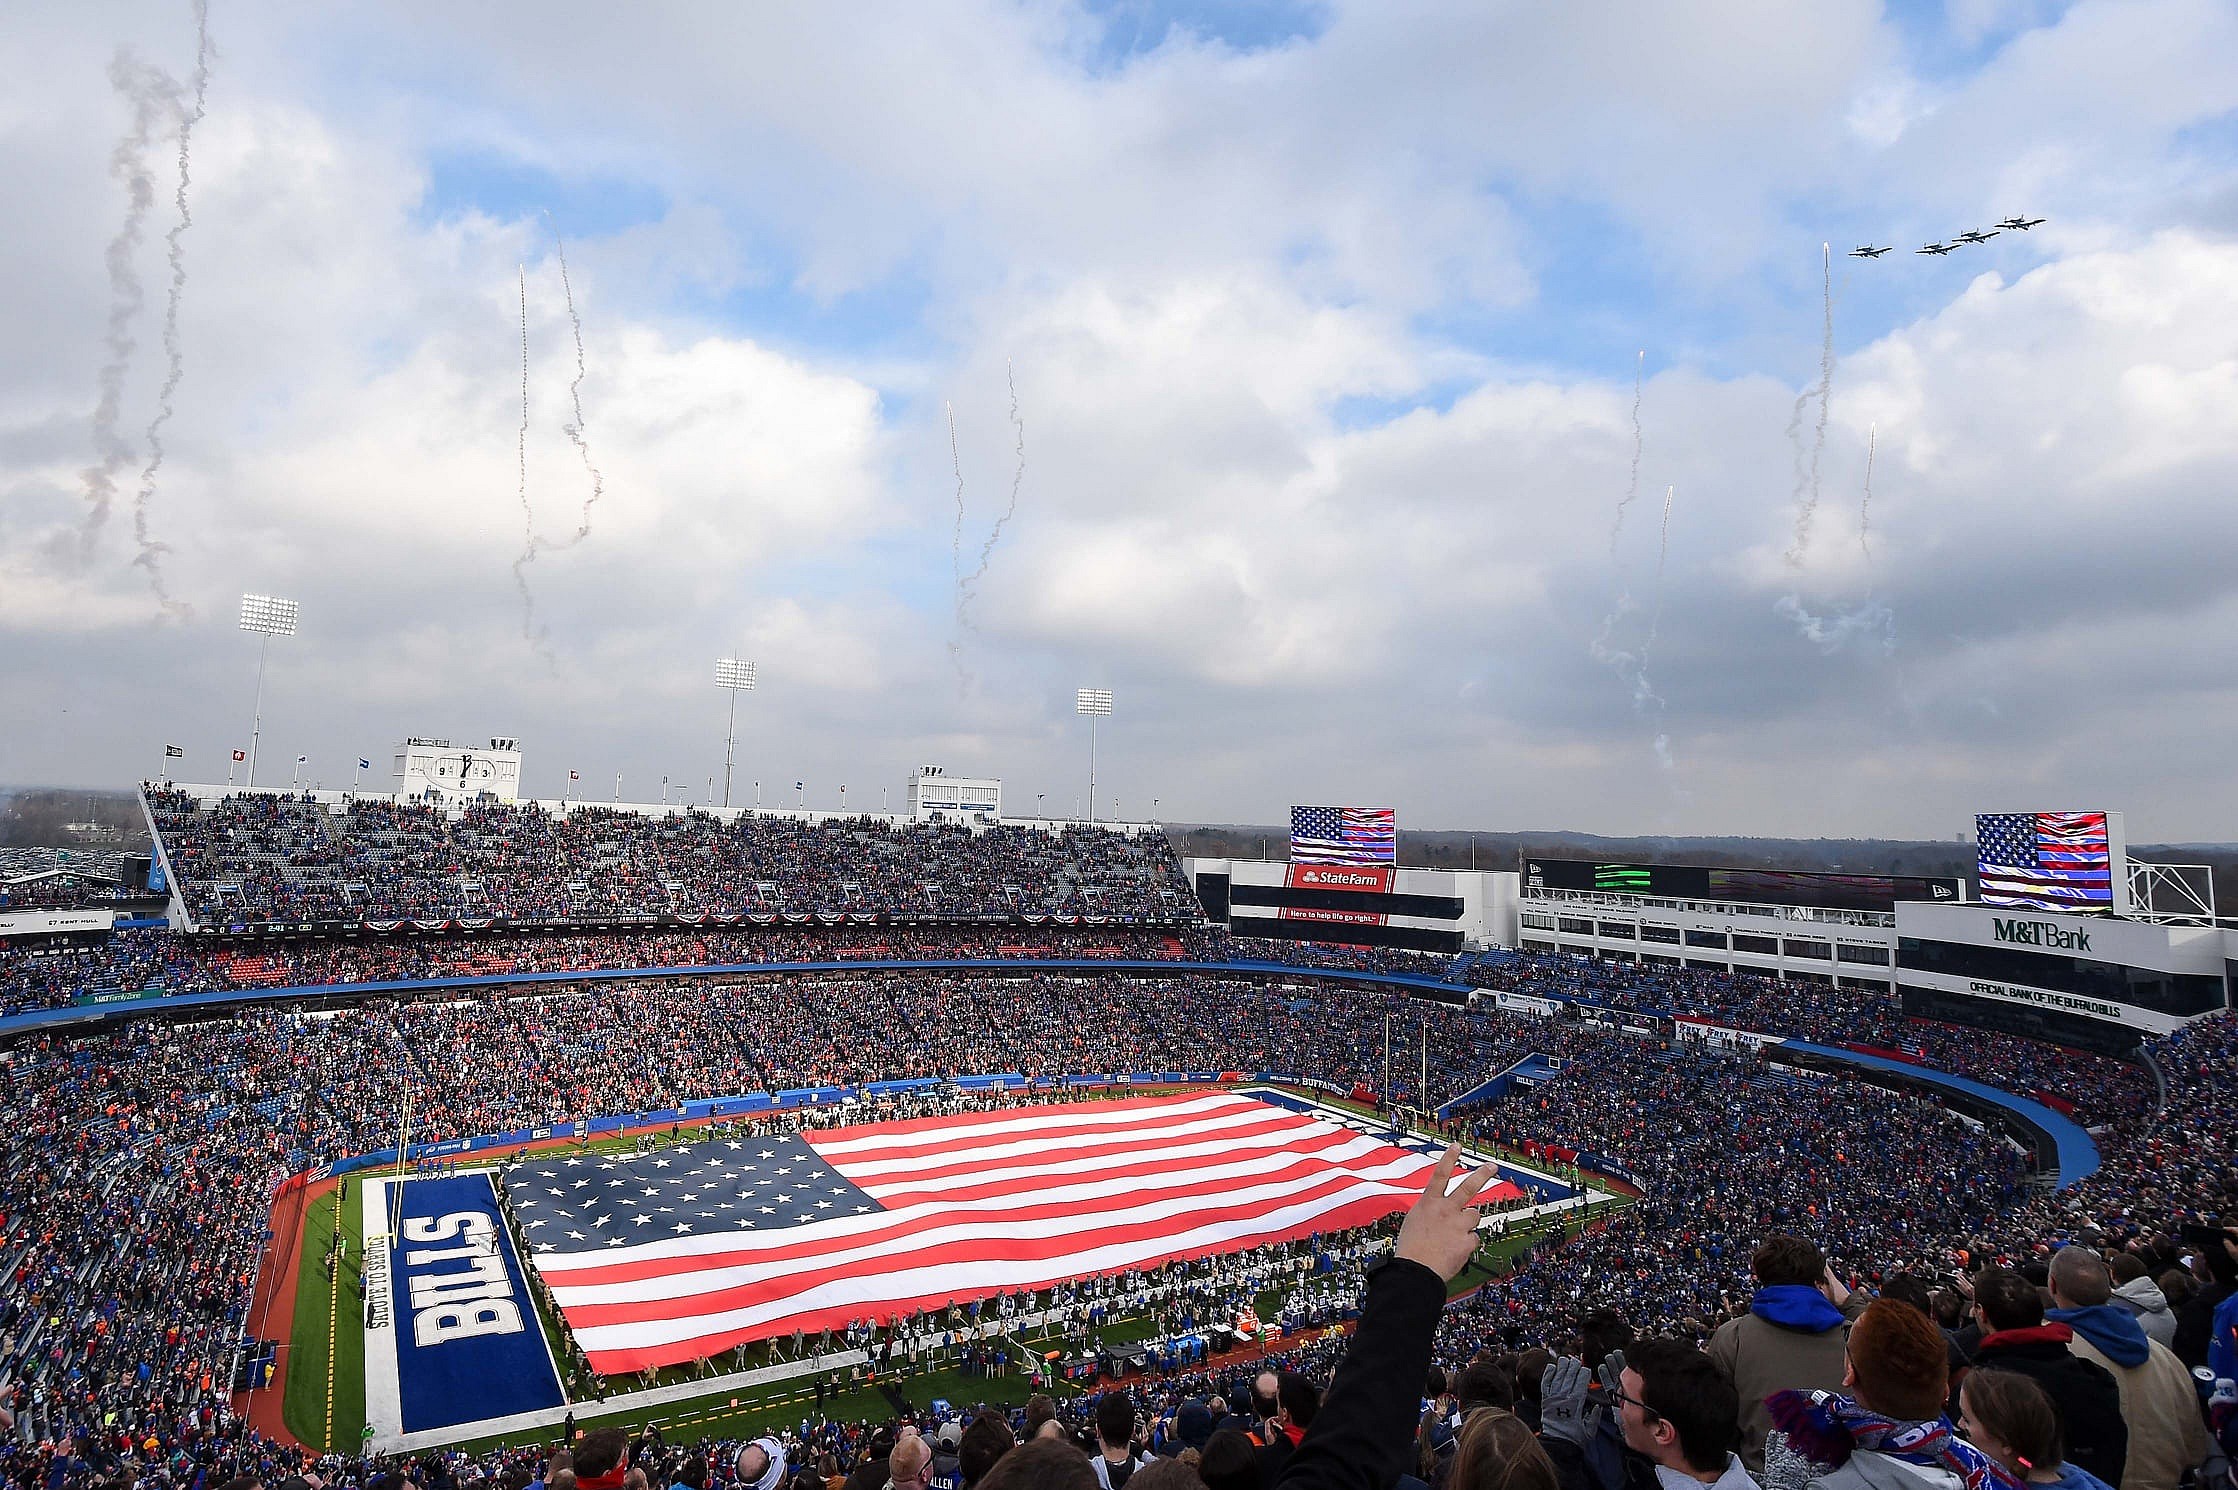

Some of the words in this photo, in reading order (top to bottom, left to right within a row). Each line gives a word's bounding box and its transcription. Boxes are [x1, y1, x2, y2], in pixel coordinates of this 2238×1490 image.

[461, 754, 472, 764] 12
[439, 767, 445, 776] 9
[482, 769, 488, 777] 3
[459, 780, 466, 788] 6
[1290, 910, 1307, 918] Here
[1316, 912, 1331, 921] help
[219, 926, 225, 934] 0
[248, 925, 254, 933] 0
[1969, 980, 2008, 997] OFFICIAL
[2008, 986, 2034, 1001] BANK
[2034, 990, 2045, 1003] OF
[2045, 992, 2064, 1007] THE
[2064, 996, 2099, 1012] BUFFALO
[2100, 1004, 2121, 1018] BILLS
[1710, 1030, 1730, 1040] FREY
[1739, 1034, 1759, 1045] FREY
[1516, 1076, 1535, 1087] BILLS
[367, 1272, 387, 1286] TO
[403, 1211, 525, 1347] BILLS
[367, 1286, 389, 1329] SALUTE
[929, 1476, 953, 1490] ALLEN
